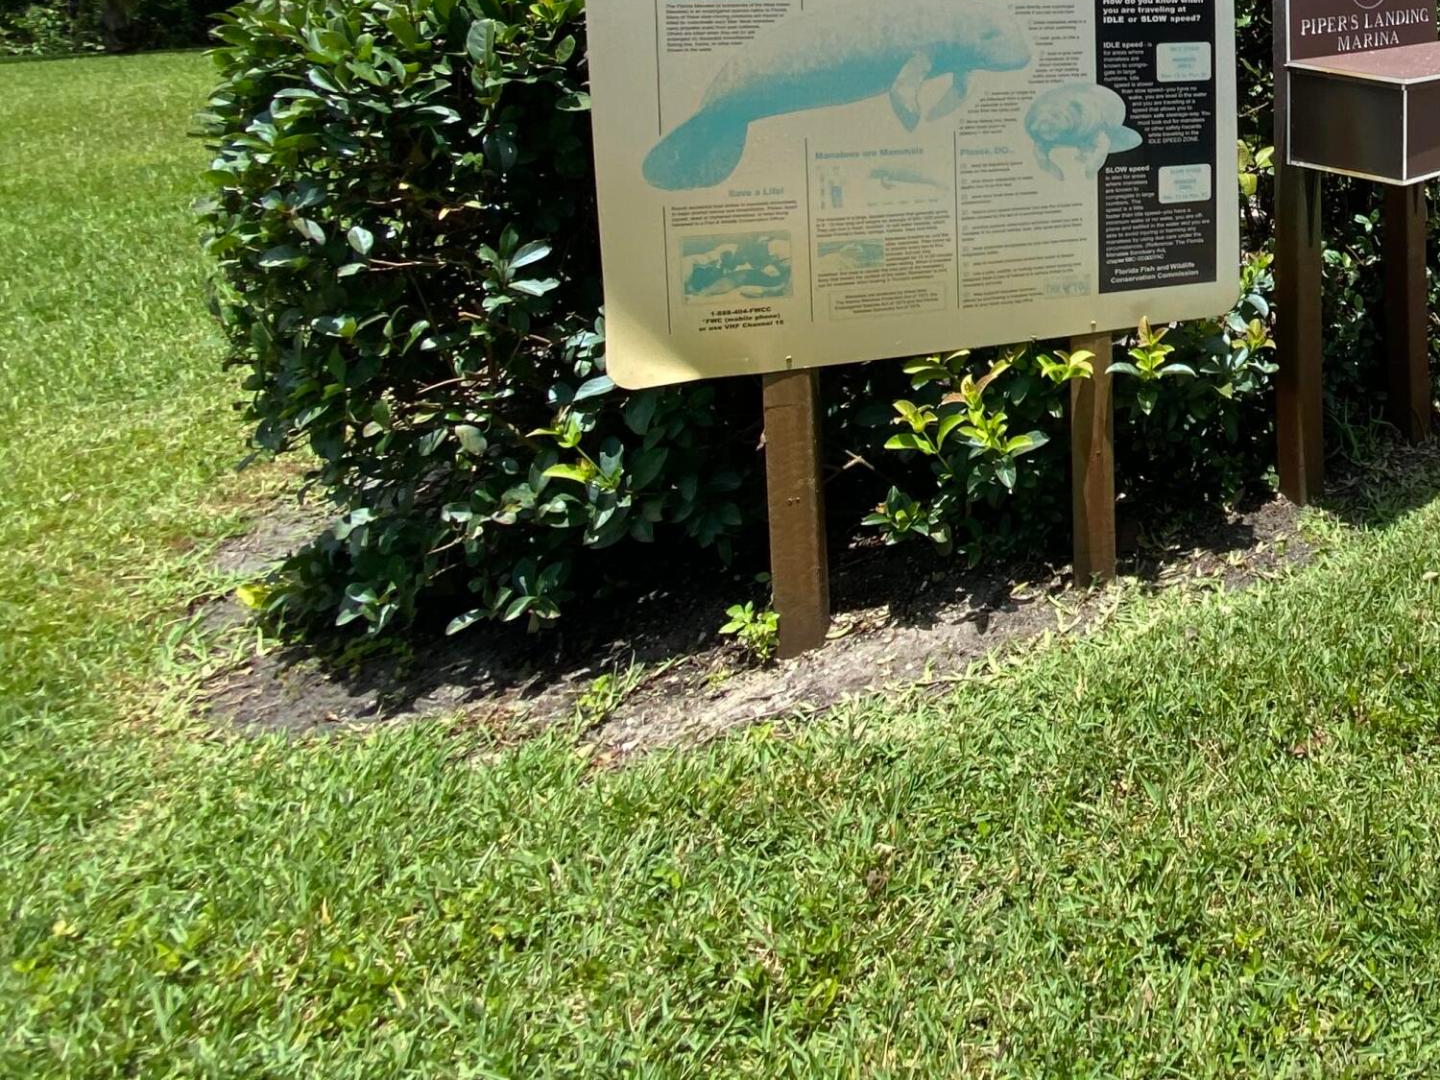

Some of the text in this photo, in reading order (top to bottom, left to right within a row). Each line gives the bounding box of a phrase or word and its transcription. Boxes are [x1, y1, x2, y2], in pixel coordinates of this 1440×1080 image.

[1103, 8, 1119, 16] you
[1137, 5, 1175, 15] traveling
[1103, 15, 1124, 24] IDLE
[1140, 15, 1167, 23] SLOW
[1170, 14, 1201, 24] speed?
[1301, 7, 1430, 36] PIPER'S LANDING
[1103, 41, 1120, 49] IDLE
[1121, 41, 1143, 49] speed
[1338, 30, 1400, 52] MARINA
[1105, 164, 1150, 174] SLOW speed
[1114, 267, 1139, 276] Florida
[1140, 265, 1155, 273] Fish
[1169, 261, 1195, 270] Wildlife
[1110, 270, 1200, 284] Conservation Commission
